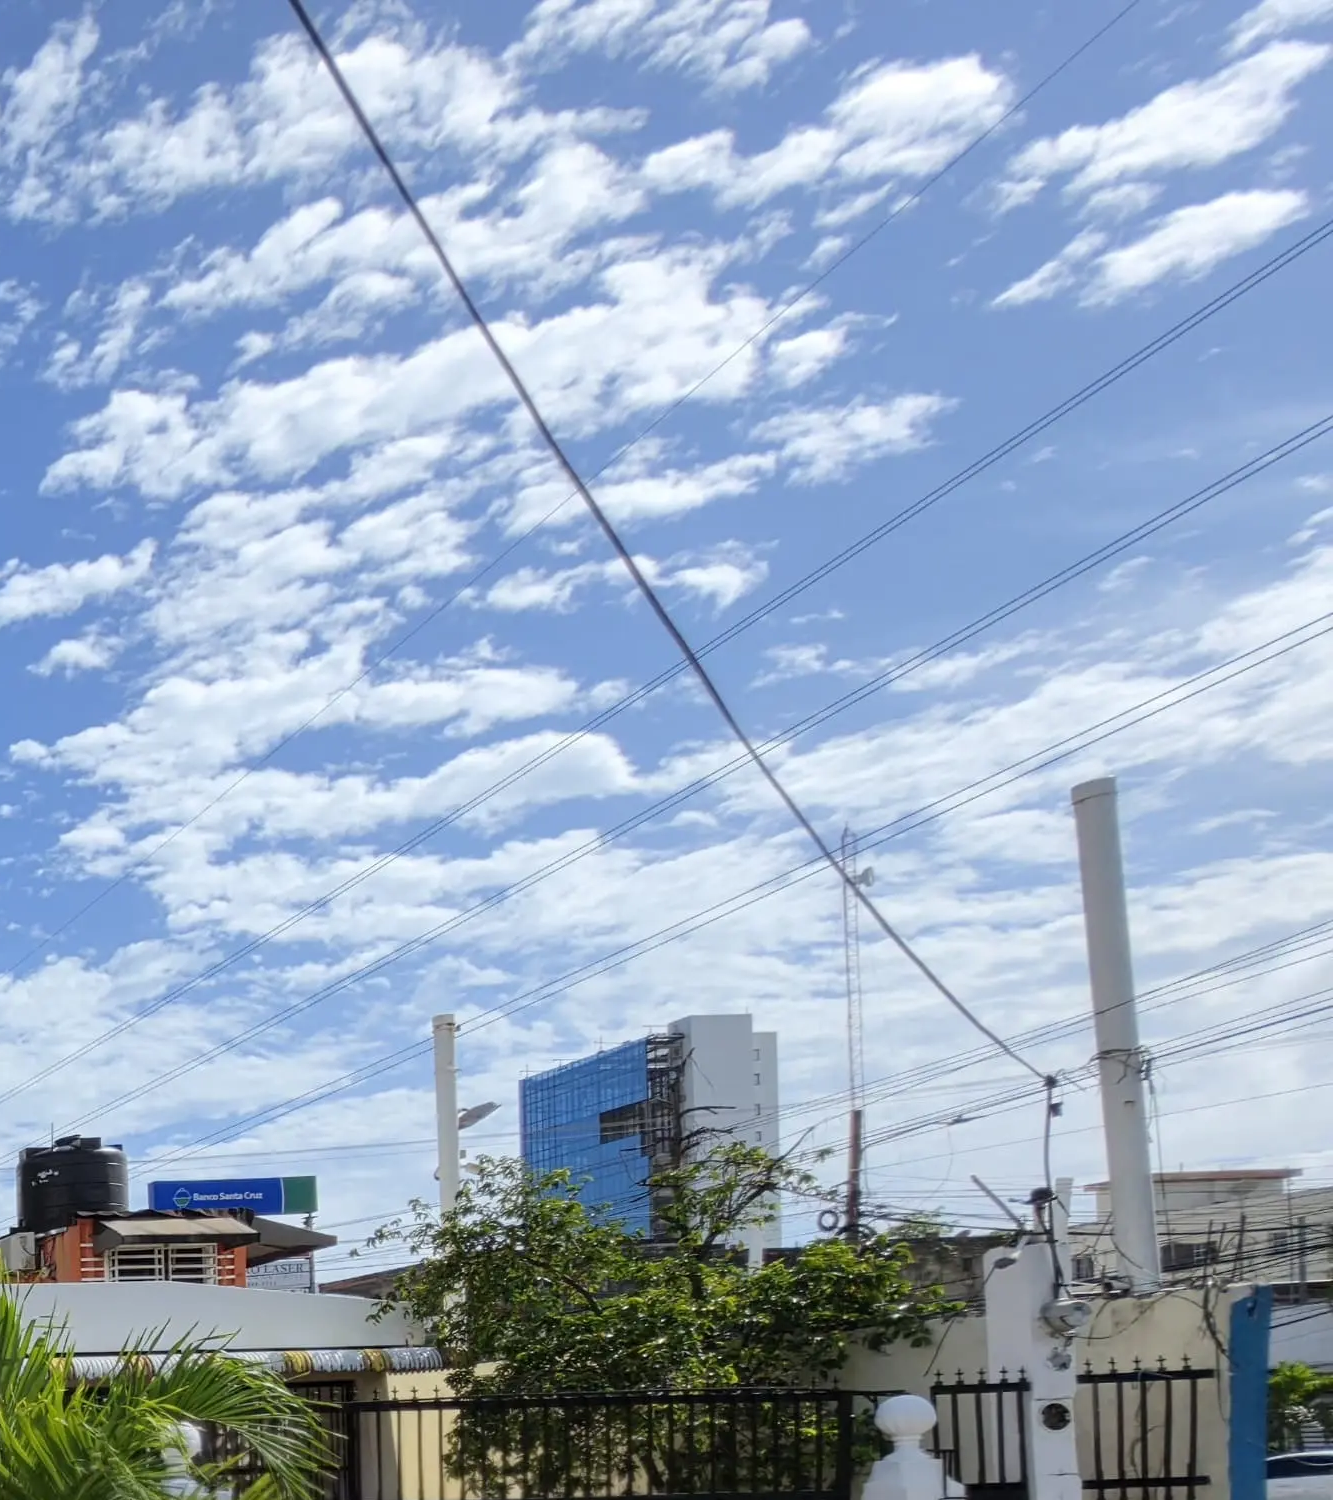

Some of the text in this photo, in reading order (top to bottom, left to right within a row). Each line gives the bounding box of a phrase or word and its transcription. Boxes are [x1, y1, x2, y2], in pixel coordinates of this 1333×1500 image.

[193, 1191, 263, 1201] Banco Santa Cruz
[264, 1263, 303, 1273] LASER
